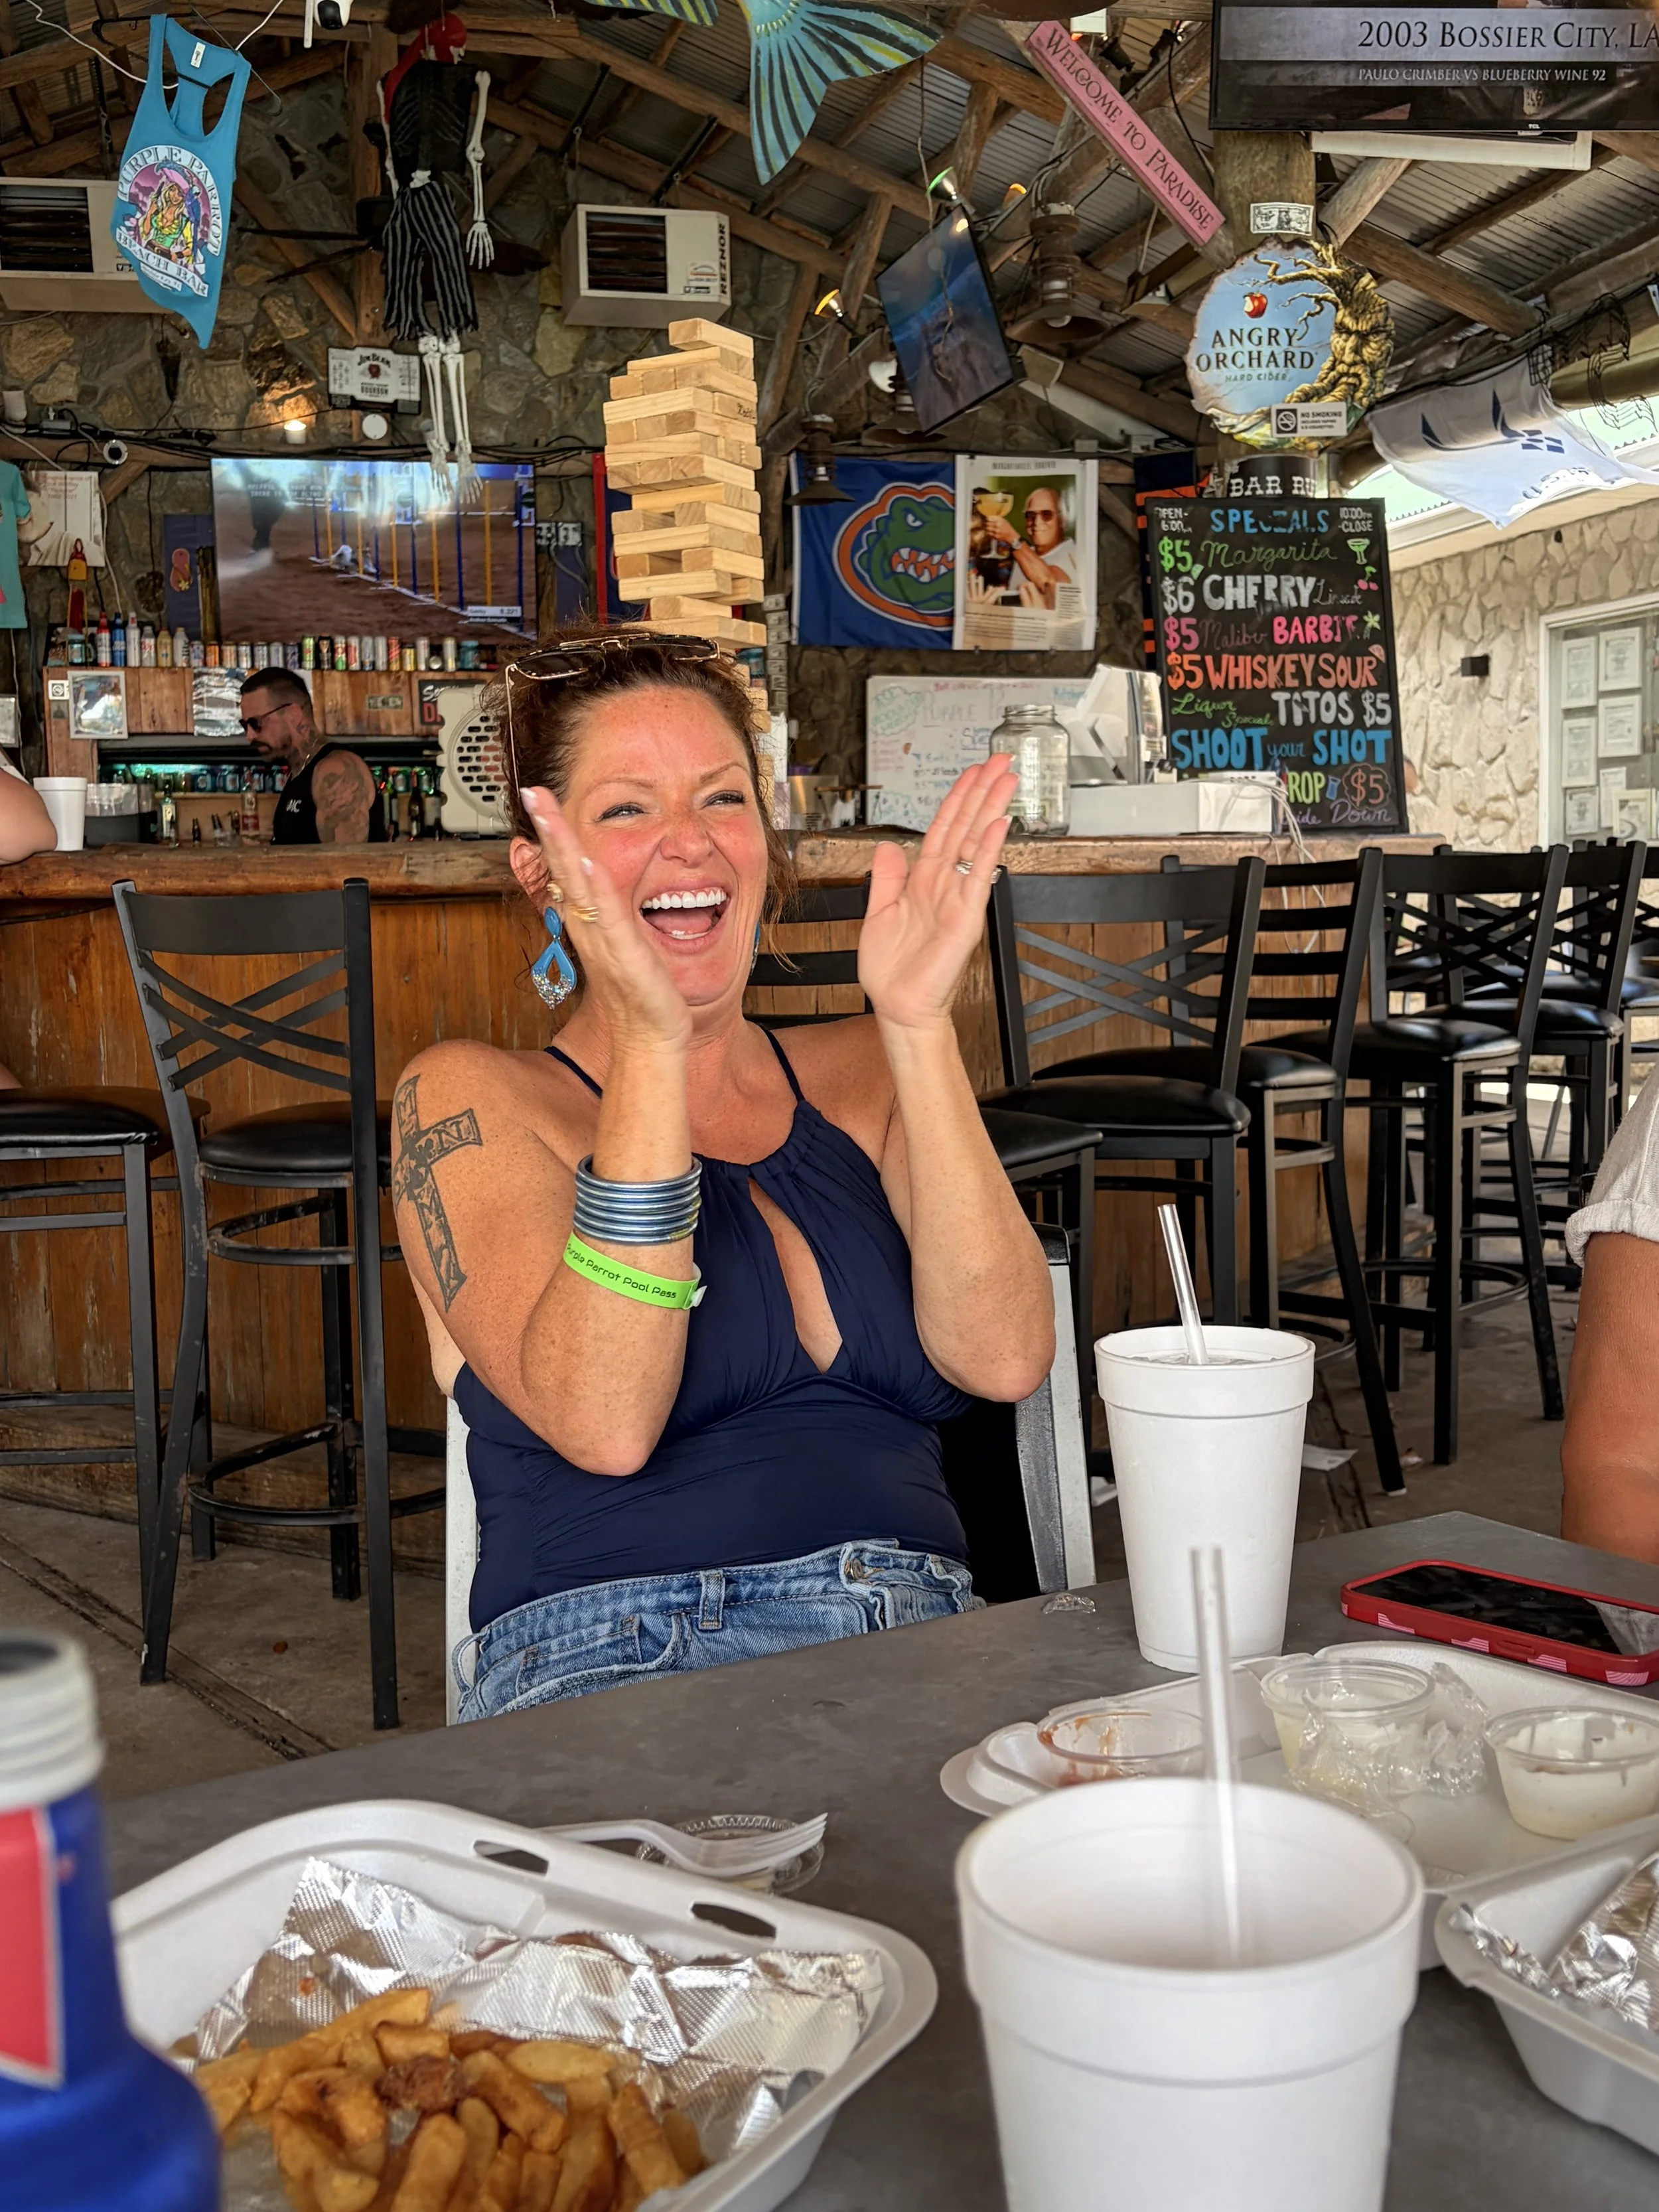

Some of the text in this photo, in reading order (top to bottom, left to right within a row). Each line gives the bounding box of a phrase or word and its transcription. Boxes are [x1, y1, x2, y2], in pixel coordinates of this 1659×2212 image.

[1358, 21, 1427, 48] 2003
[1439, 22, 1547, 48] BOSSIER
[1629, 23, 1659, 48] LA
[1359, 68, 1606, 81] PAULO CRIMBER VS BLUEBERRY WINE 92
[1045, 29, 1214, 229] WELCOME TO PARADISE
[118, 147, 181, 198] PURPLE
[718, 223, 727, 294] REZNOR
[177, 266, 208, 295] BAR
[1196, 327, 1315, 372] ANGRY ORCHARD
[1225, 371, 1289, 383] HARD CIDER
[1230, 475, 1283, 498] BAR
[1158, 536, 1338, 573] $5 Margarita
[1161, 575, 1194, 615] $6
[1202, 574, 1317, 611] CHERRY
[1164, 615, 1199, 652] $5
[1199, 618, 1268, 648] Malibu
[1167, 652, 1378, 690] $5 WHISKEY SOUR
[1171, 693, 1237, 719] Liquor
[1361, 690, 1392, 728] $5
[1170, 727, 1392, 770] SHOOT your SHOT
[1350, 769, 1385, 807] $5
[1329, 798, 1392, 824] Down
[586, 1259, 621, 1282] Parrot
[622, 1276, 650, 1293] Pool
[652, 1286, 677, 1299] Pass
